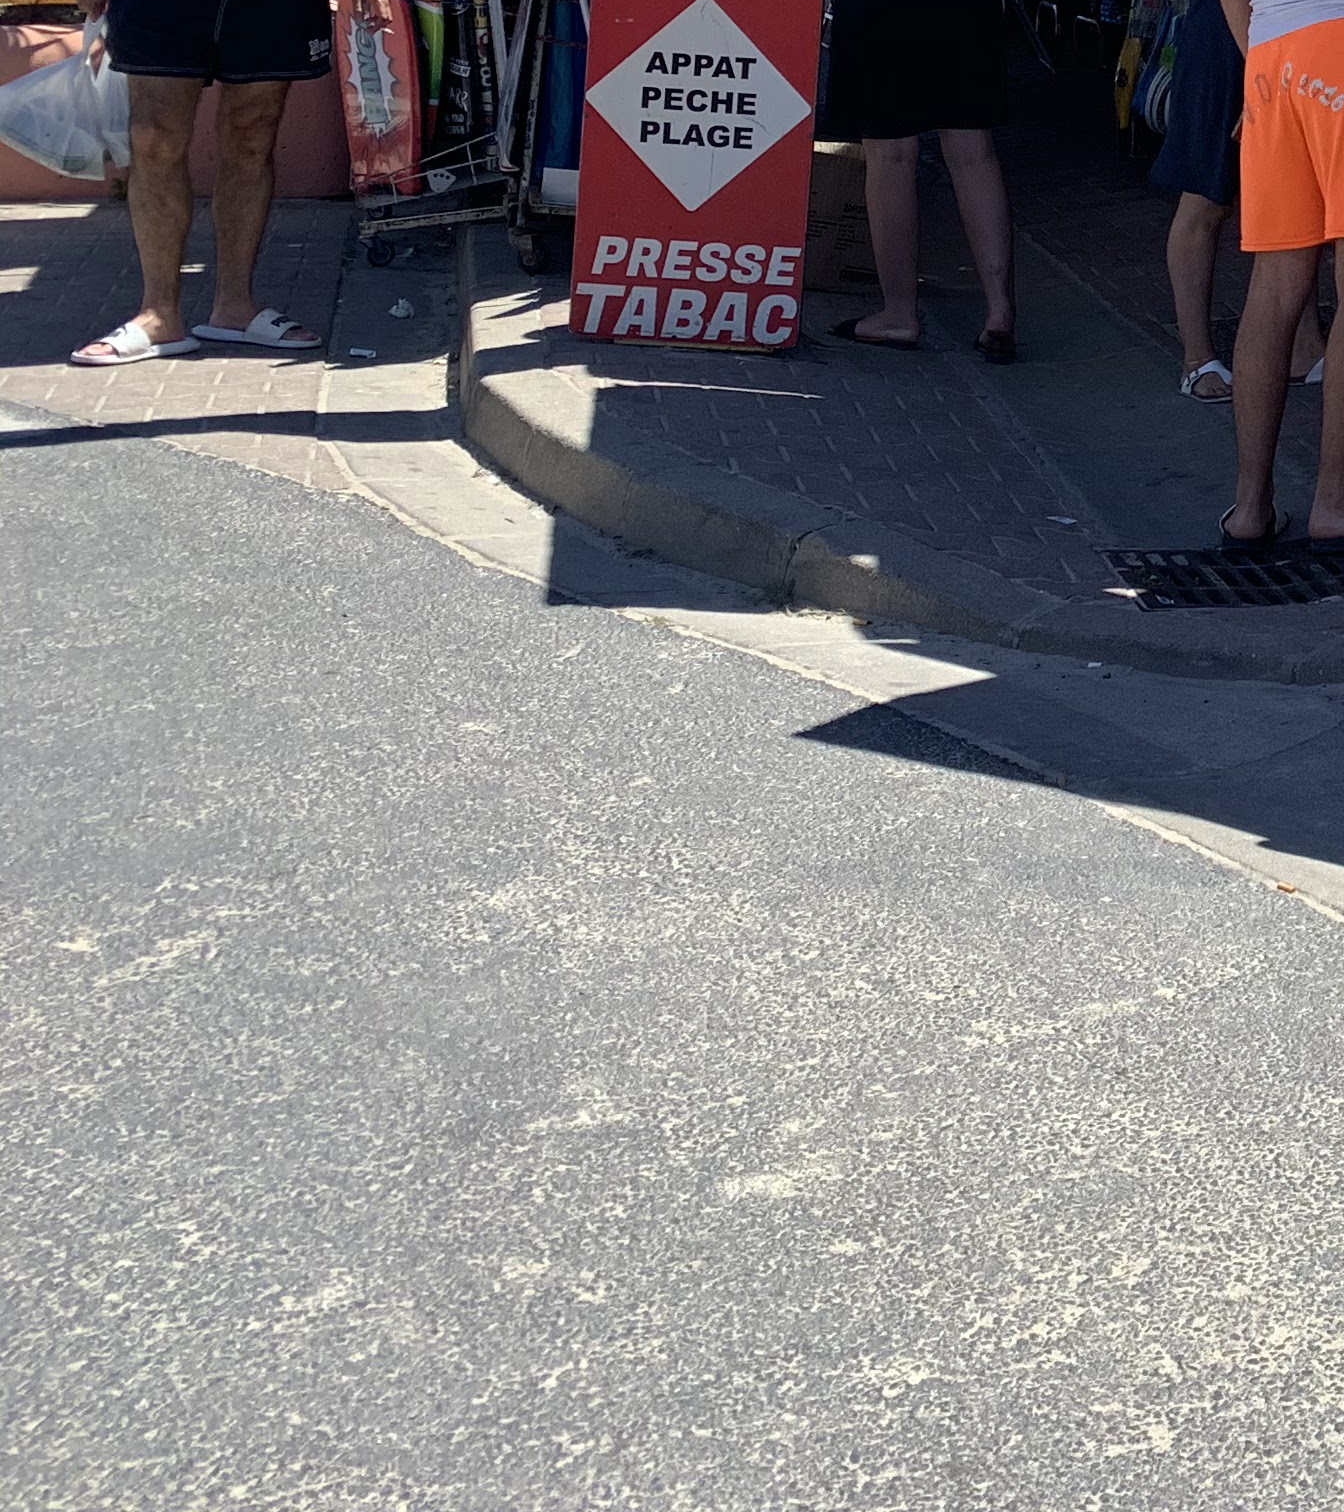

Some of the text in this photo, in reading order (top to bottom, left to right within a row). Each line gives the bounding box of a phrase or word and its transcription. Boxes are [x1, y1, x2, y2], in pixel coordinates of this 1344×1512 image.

[645, 51, 757, 80] APPAT
[641, 86, 757, 116] PECHE
[640, 120, 754, 150] PLAGE
[590, 234, 802, 286] PRESSE
[575, 282, 798, 346] TABAC
